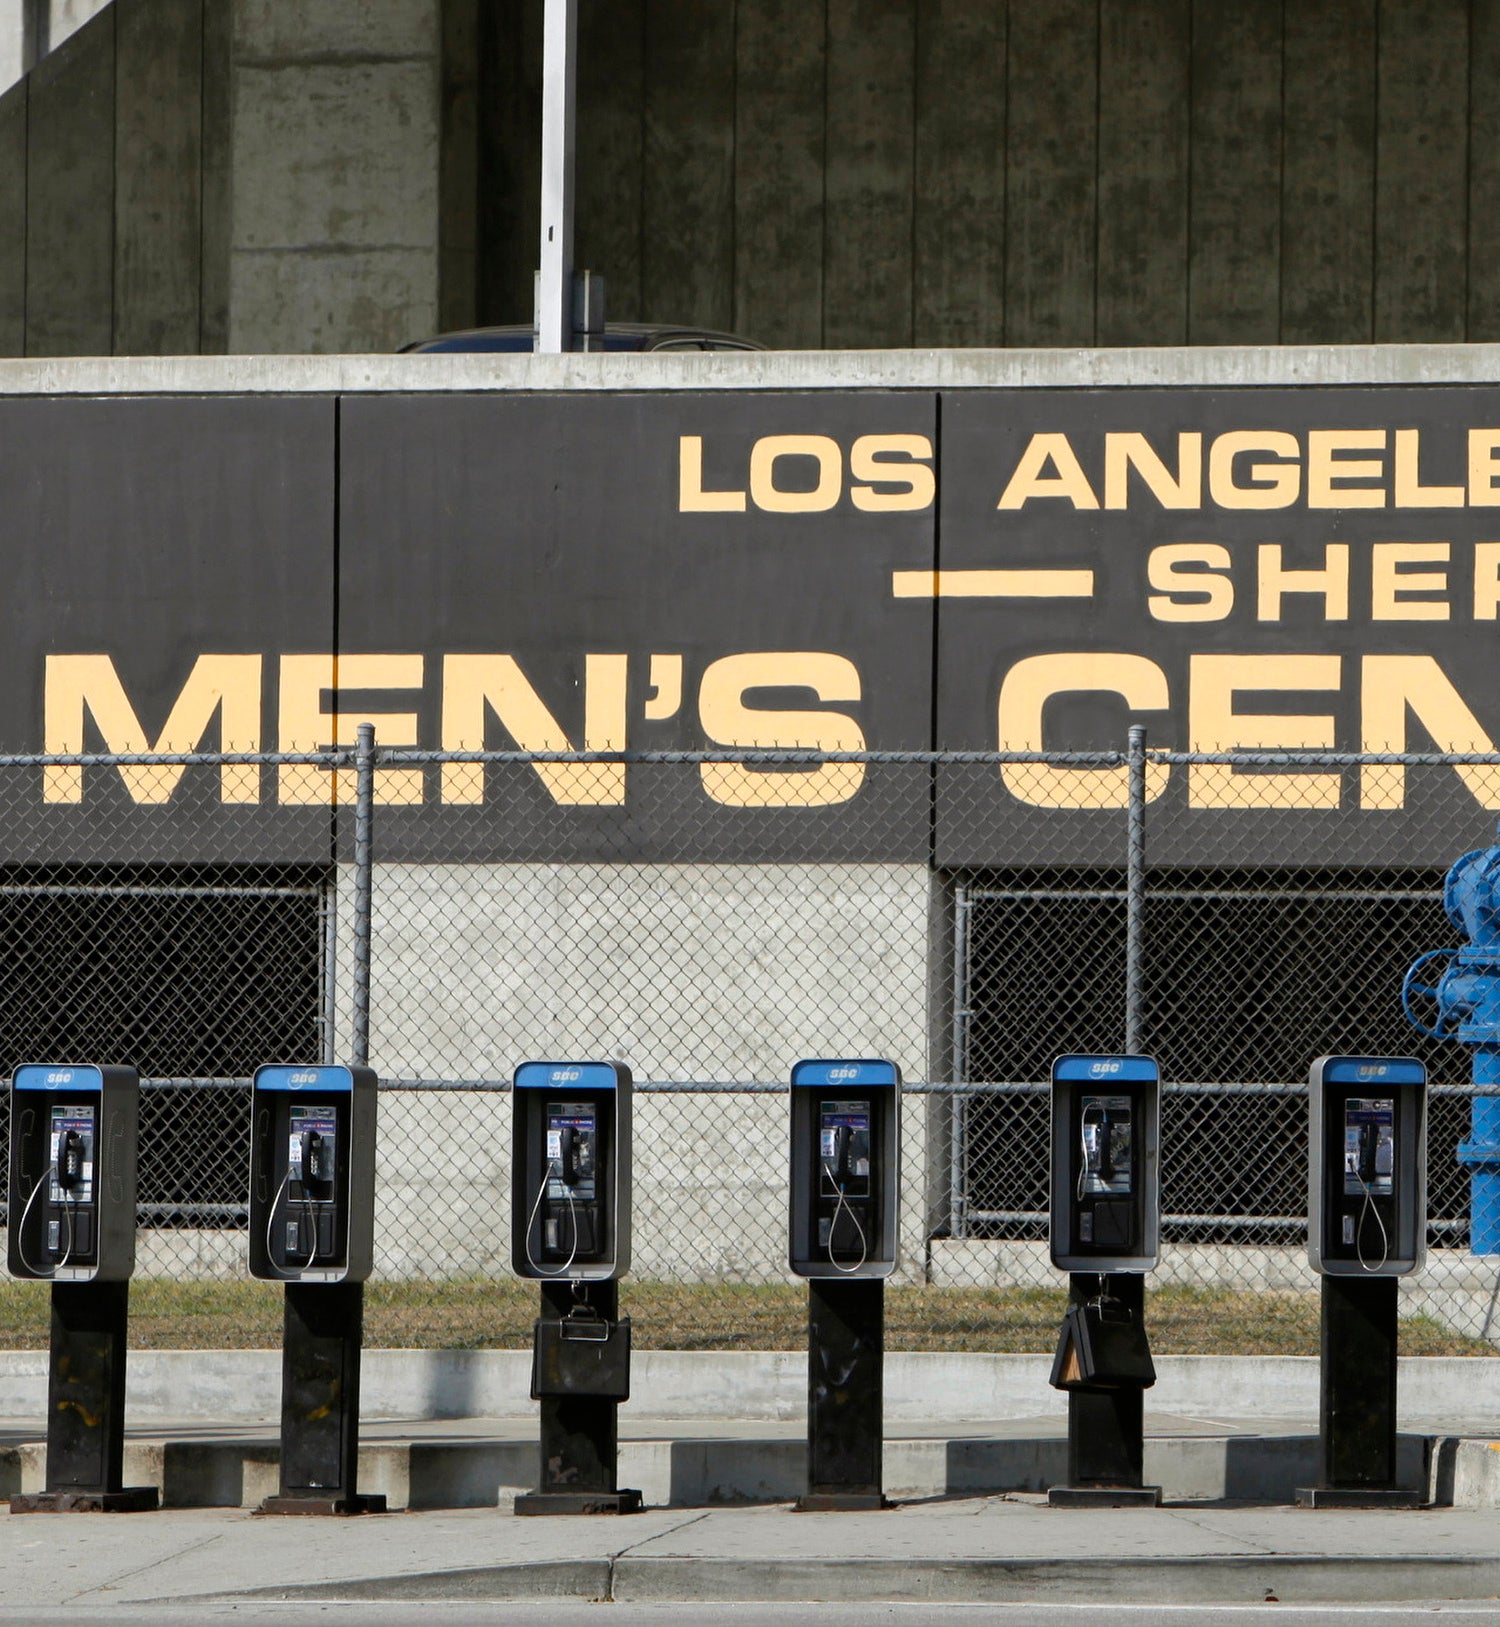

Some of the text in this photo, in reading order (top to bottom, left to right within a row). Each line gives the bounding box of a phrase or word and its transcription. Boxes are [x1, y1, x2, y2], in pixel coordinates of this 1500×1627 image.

[679, 433, 936, 514] LOS
[43, 651, 868, 808] MEN'S
[829, 1068, 860, 1080] SBC
